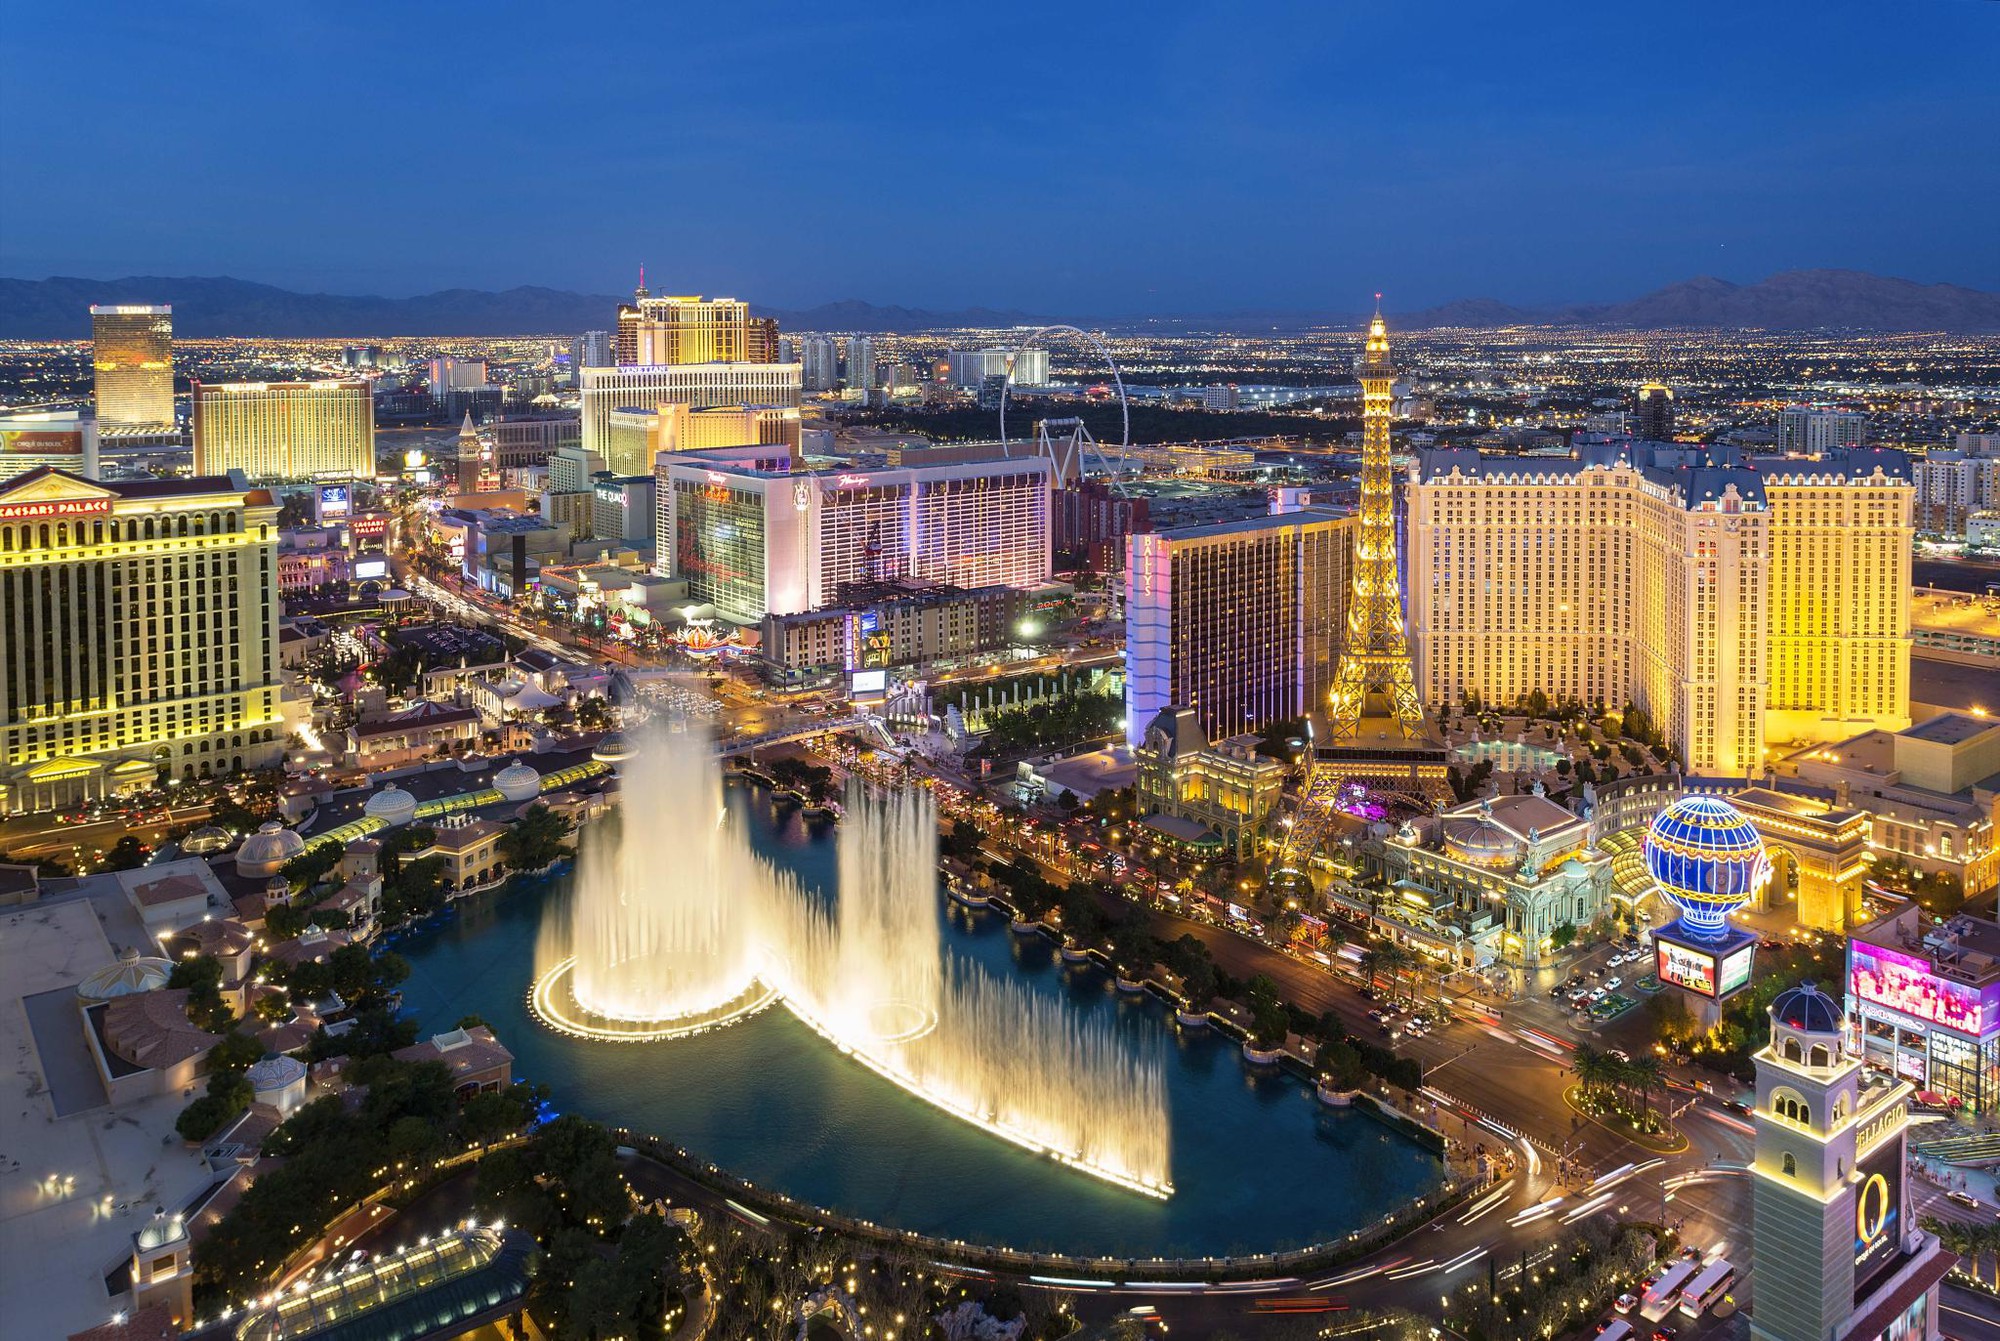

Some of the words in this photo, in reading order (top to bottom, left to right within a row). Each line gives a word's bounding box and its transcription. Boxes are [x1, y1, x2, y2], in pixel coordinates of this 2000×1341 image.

[117, 305, 152, 314] TRUMP
[597, 488, 607, 500] THE
[59, 501, 108, 513] PALACE
[354, 520, 384, 528] CAESARS
[355, 526, 384, 534] PALACE
[33, 774, 63, 783] CAESARS
[1931, 1030, 1970, 1049] URBAN
[1856, 1103, 1904, 1148] ELLAGIO
